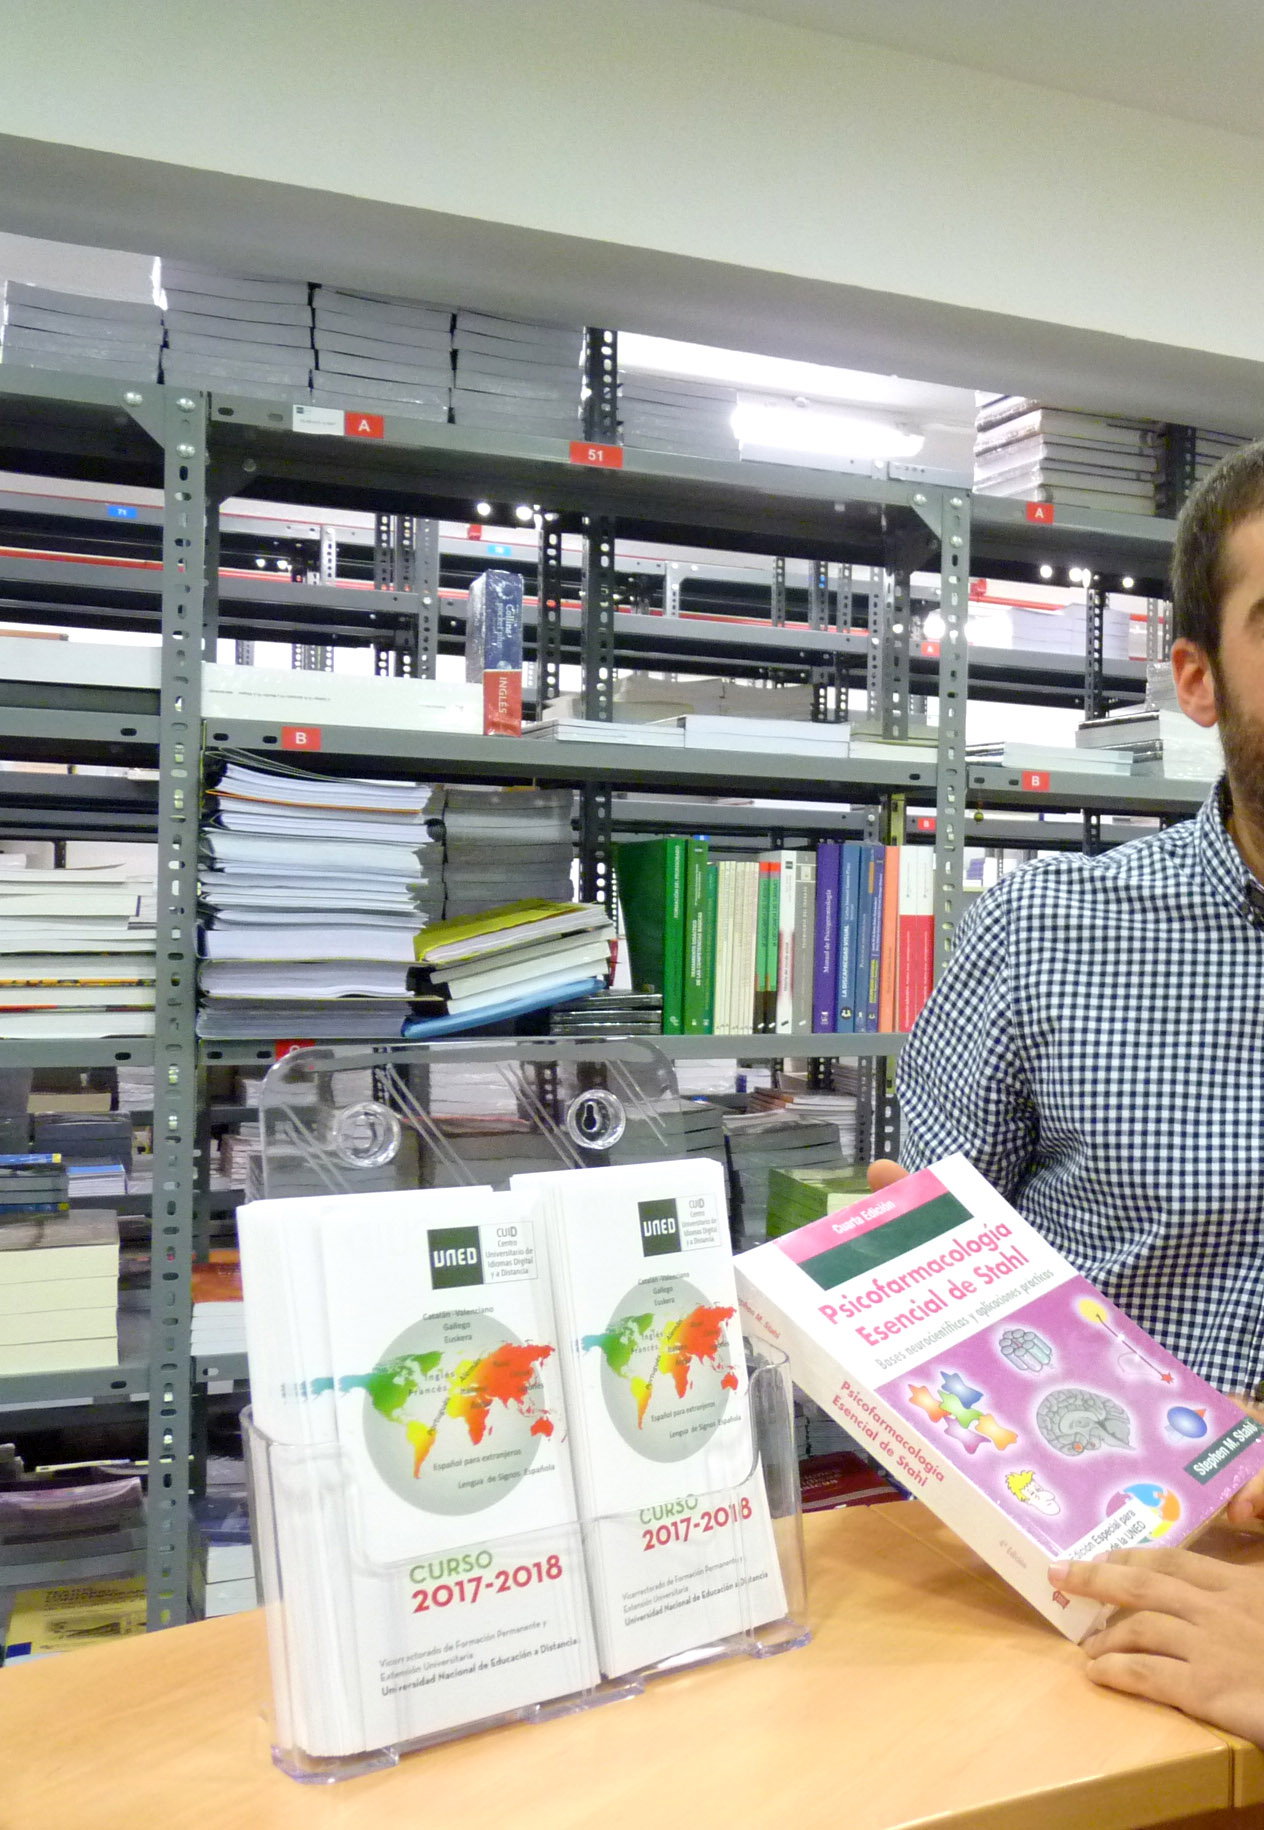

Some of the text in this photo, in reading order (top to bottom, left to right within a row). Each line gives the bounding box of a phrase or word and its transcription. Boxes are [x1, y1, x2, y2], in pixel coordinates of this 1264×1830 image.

[358, 419, 371, 432] A
[588, 448, 604, 461] 51
[1034, 508, 1044, 518] A
[498, 676, 509, 714] INGLÉS
[296, 732, 307, 745] B
[1032, 776, 1040, 786] B
[842, 990, 848, 998] LA
[688, 1198, 705, 1209] CUID
[643, 1218, 676, 1237] UNED
[832, 1199, 896, 1236] Cuarta Edición
[496, 1226, 518, 1238] CUID
[485, 1247, 533, 1258] Universitario de
[498, 1240, 518, 1248] Centro
[433, 1247, 478, 1268] UNED
[488, 1256, 534, 1268] Idiomas Digital
[501, 1268, 529, 1277] Distancia
[818, 1221, 1013, 1325] Psicofarmacología
[652, 1286, 674, 1296] Gallego
[855, 1245, 1030, 1347] Esencial de Stahl
[443, 1321, 471, 1332] Gallego
[874, 1352, 906, 1371] Bases
[970, 1312, 978, 1324] y
[975, 1287, 1022, 1319] aplicaciones
[444, 1334, 472, 1344] Euskera
[424, 1370, 456, 1383] Inglés
[409, 1385, 448, 1396] Francés
[651, 1412, 672, 1422] Español
[673, 1409, 685, 1418] para
[832, 1394, 930, 1488] Esencial de Stahl
[1193, 1421, 1259, 1476] Stephen M. Stahl
[433, 1449, 522, 1471] Español para extranjeros
[458, 1464, 555, 1489] Lengua de Signos Española
[640, 1494, 699, 1525] CURSO
[642, 1497, 752, 1552] 2017-2018
[1091, 1509, 1136, 1545] Especial para
[1117, 1537, 1128, 1546] la
[1124, 1520, 1146, 1540] UNED
[409, 1550, 493, 1585] CURSO
[411, 1554, 563, 1614] 2017-2018
[622, 1580, 666, 1600] Vicerrectorado
[666, 1578, 674, 1586] de
[675, 1568, 704, 1583] Formación
[624, 1586, 689, 1614] Extensión Universitaria
[625, 1607, 663, 1626] Universidad
[664, 1598, 692, 1613] Nacional
[692, 1595, 700, 1603] de
[702, 1584, 734, 1600] Educación
[443, 1643, 454, 1653] de
[456, 1632, 495, 1649] Formación
[497, 1622, 541, 1638] Permanente
[542, 1620, 548, 1629] y
[380, 1652, 474, 1682] Extensión Universitaria
[382, 1638, 578, 1696] Universidad Nacional de Educación a Distancia
